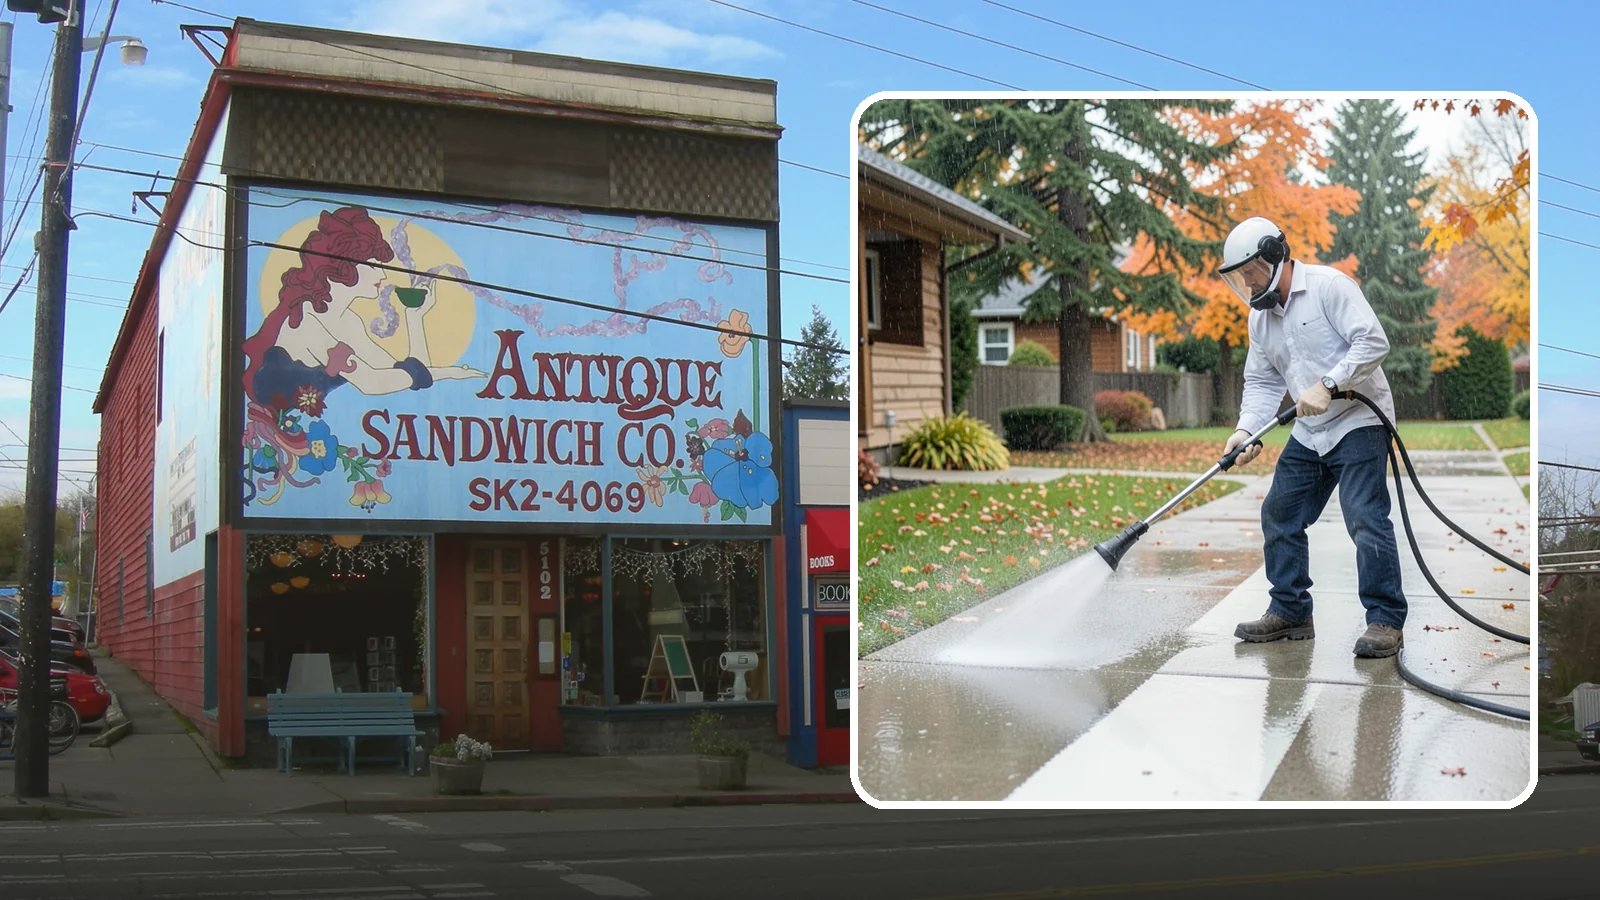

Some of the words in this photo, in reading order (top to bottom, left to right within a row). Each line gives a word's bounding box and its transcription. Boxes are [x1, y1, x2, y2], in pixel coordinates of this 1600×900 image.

[476, 329, 724, 421] ANTIQUE
[361, 409, 604, 466] SANDWICH
[617, 417, 685, 469] CO.
[469, 477, 646, 512] SK2-4069
[540, 542, 552, 600] 5102
[809, 555, 835, 569] BOOKS
